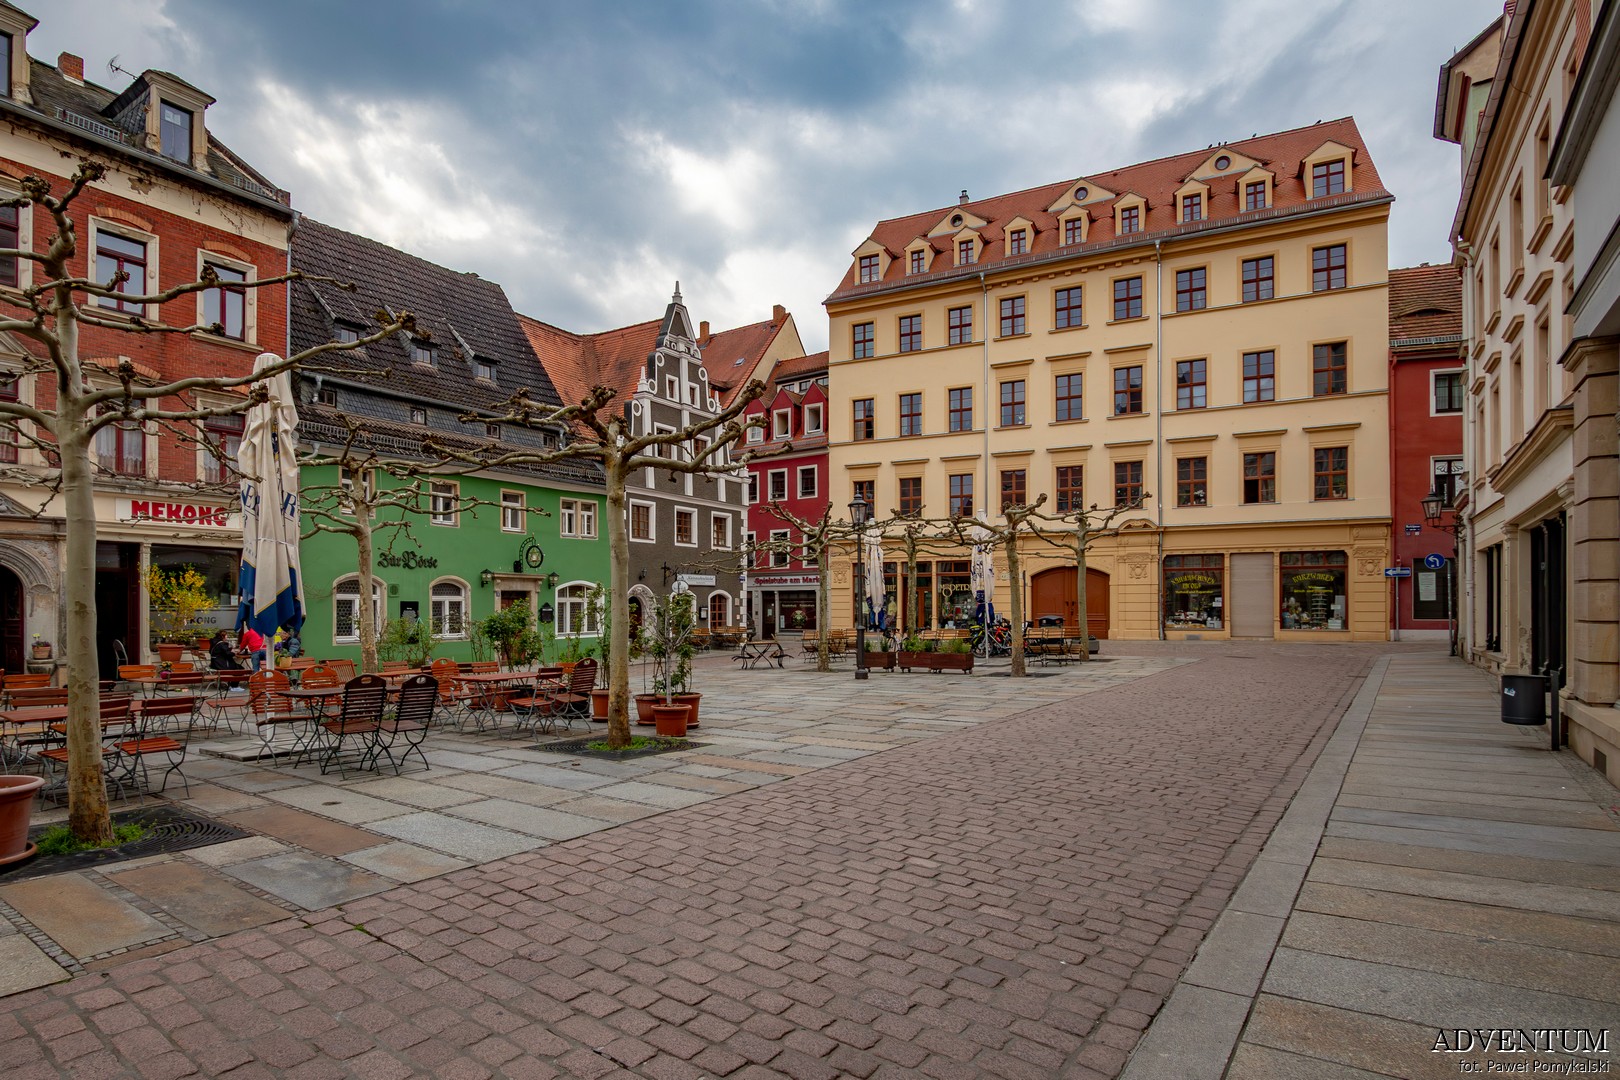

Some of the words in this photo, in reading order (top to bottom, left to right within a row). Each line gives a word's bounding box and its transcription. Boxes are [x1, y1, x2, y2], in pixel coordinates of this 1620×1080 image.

[131, 500, 227, 526] MEKONG
[402, 550, 438, 570] Börse
[755, 576, 788, 586] Spielstube
[801, 576, 820, 584] Mark
